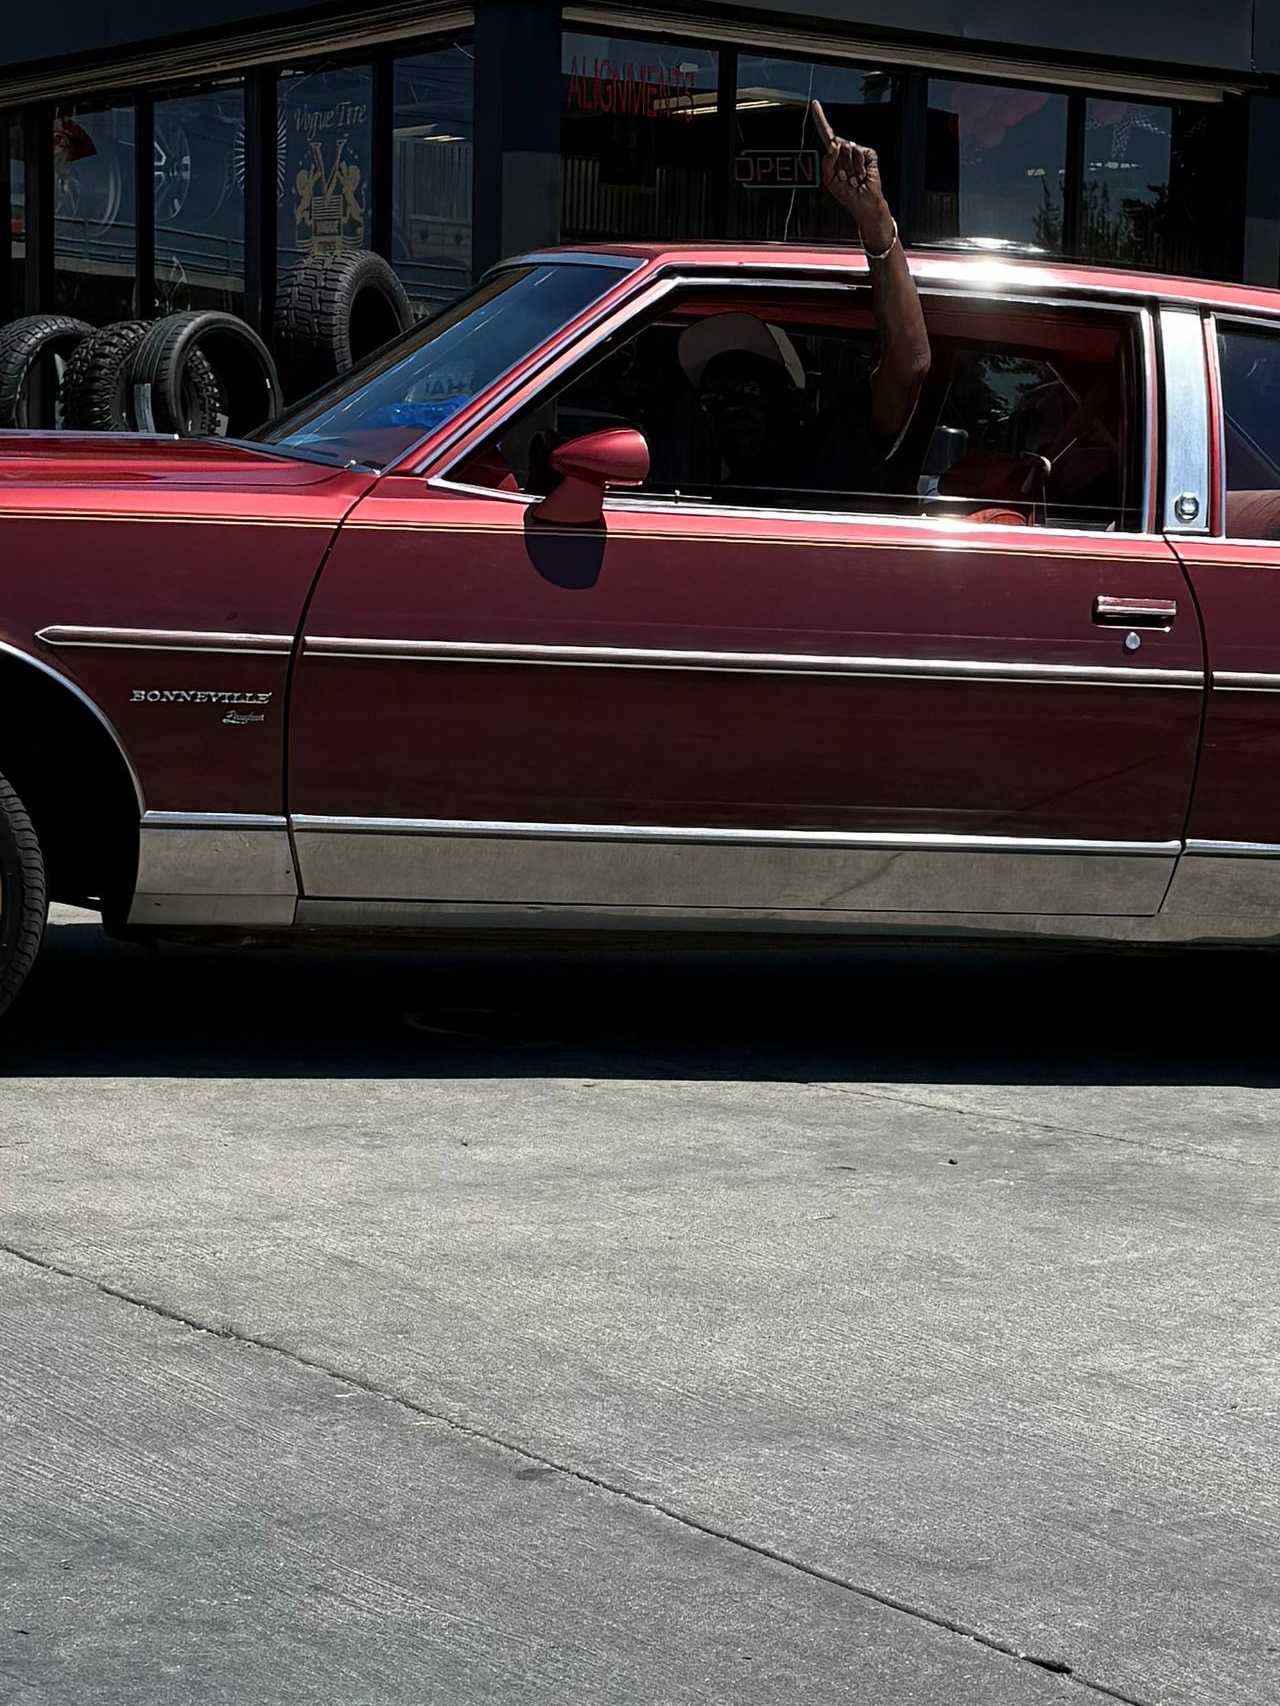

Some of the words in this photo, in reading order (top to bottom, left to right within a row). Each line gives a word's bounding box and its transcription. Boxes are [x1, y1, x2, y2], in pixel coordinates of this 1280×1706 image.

[294, 104, 335, 141] Vogue
[735, 157, 813, 182] OPEN
[130, 690, 272, 704] BONNEVILLE
